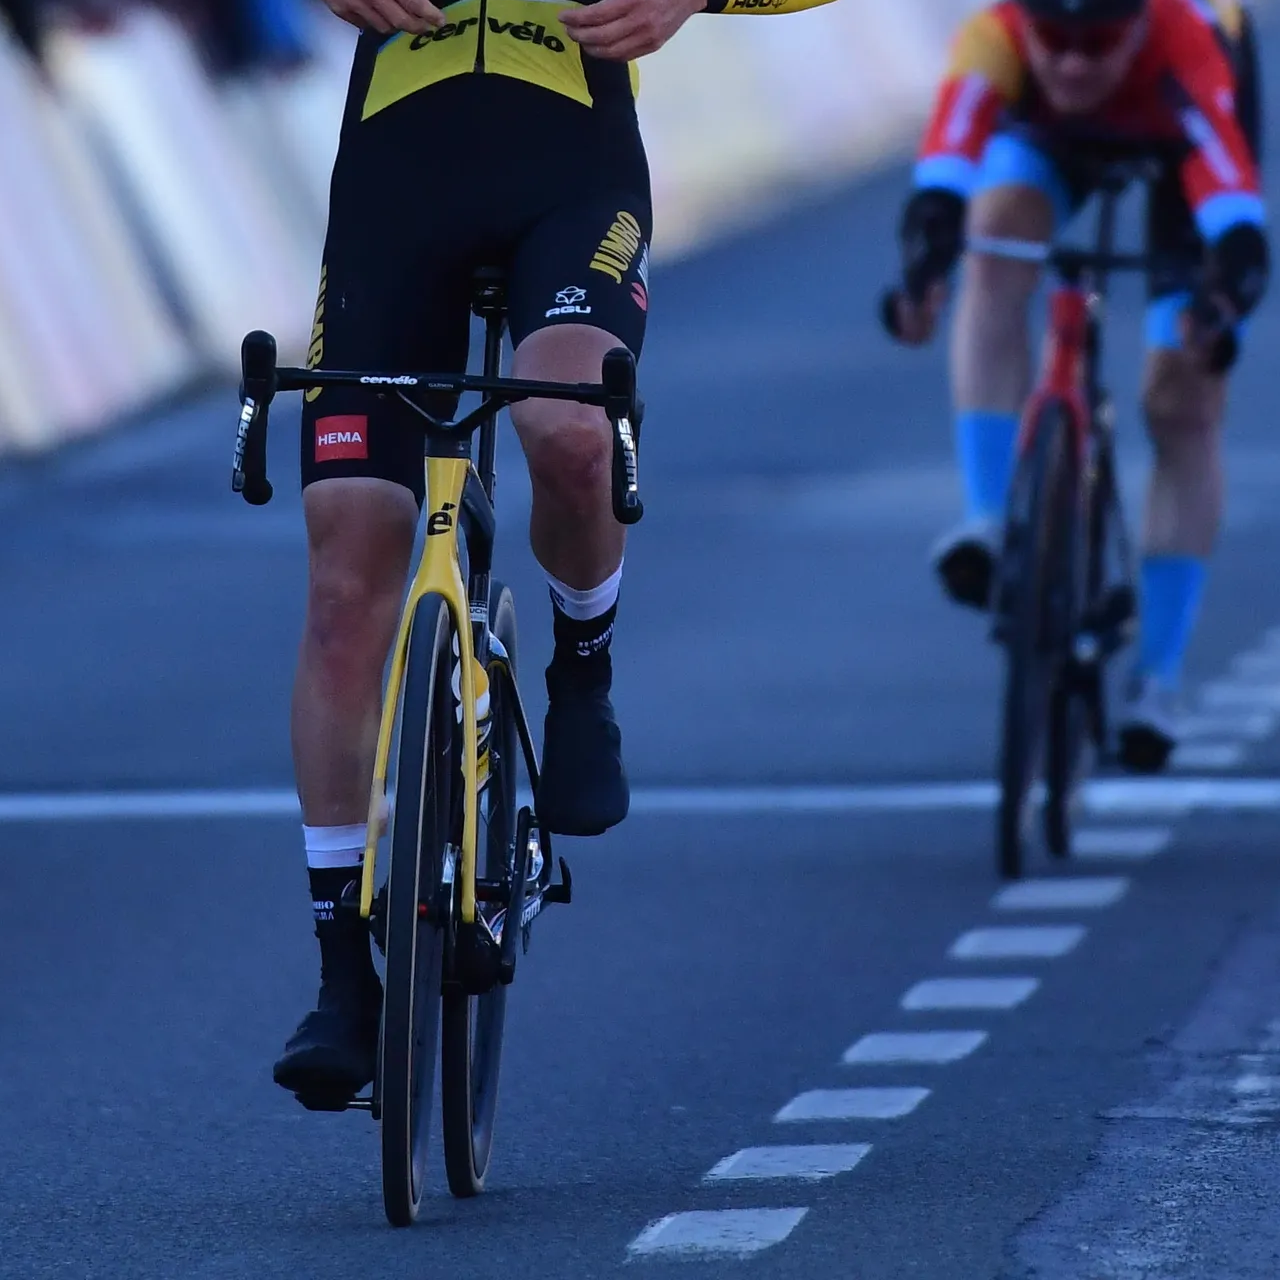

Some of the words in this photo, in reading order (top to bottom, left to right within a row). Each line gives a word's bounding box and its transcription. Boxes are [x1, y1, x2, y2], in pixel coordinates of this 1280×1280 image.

[410, 17, 565, 53] cervélo
[589, 211, 641, 284] JUMBO
[545, 305, 591, 318] AGU
[360, 375, 418, 385] cervélo
[233, 396, 255, 472] SRAM
[318, 431, 363, 446] HEMA
